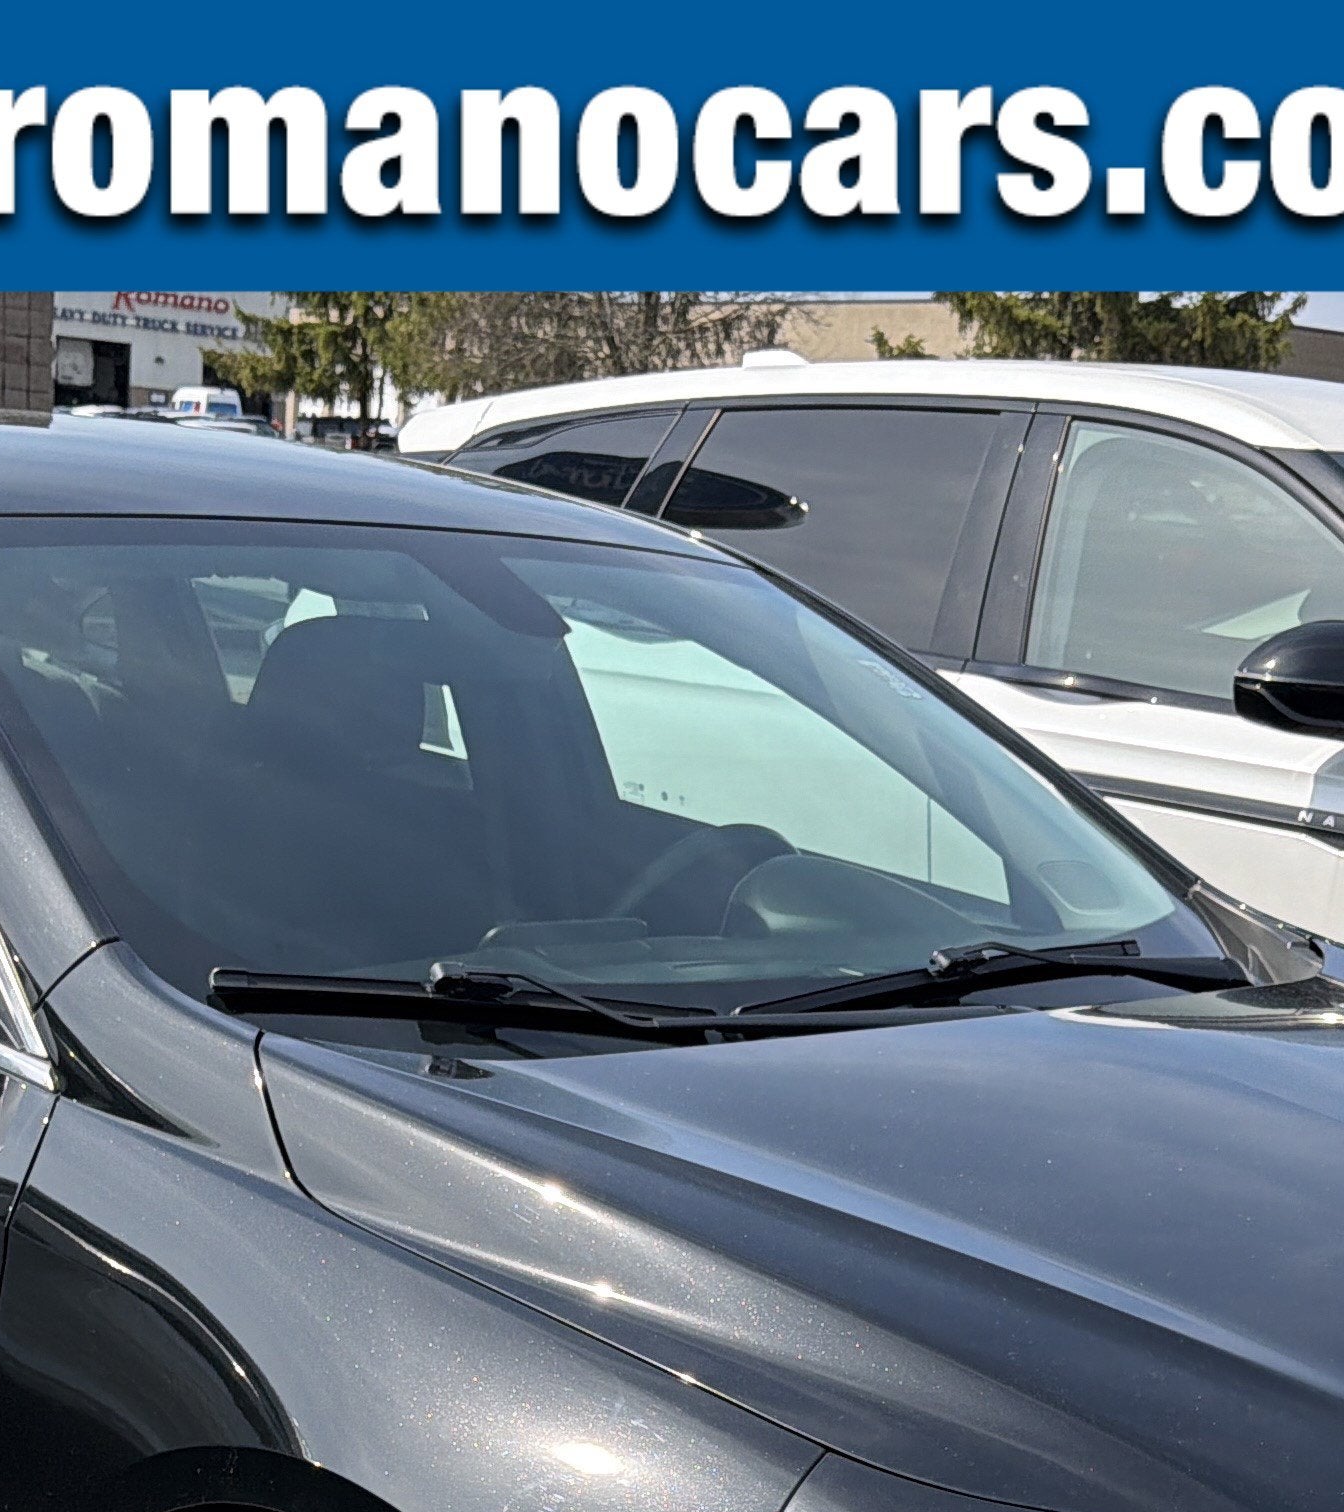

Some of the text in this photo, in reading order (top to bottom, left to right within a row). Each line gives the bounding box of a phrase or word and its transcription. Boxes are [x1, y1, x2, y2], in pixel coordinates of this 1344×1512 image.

[91, 310, 129, 327] DUTY
[135, 314, 180, 333] TRUCK
[185, 320, 239, 340] SERVICE
